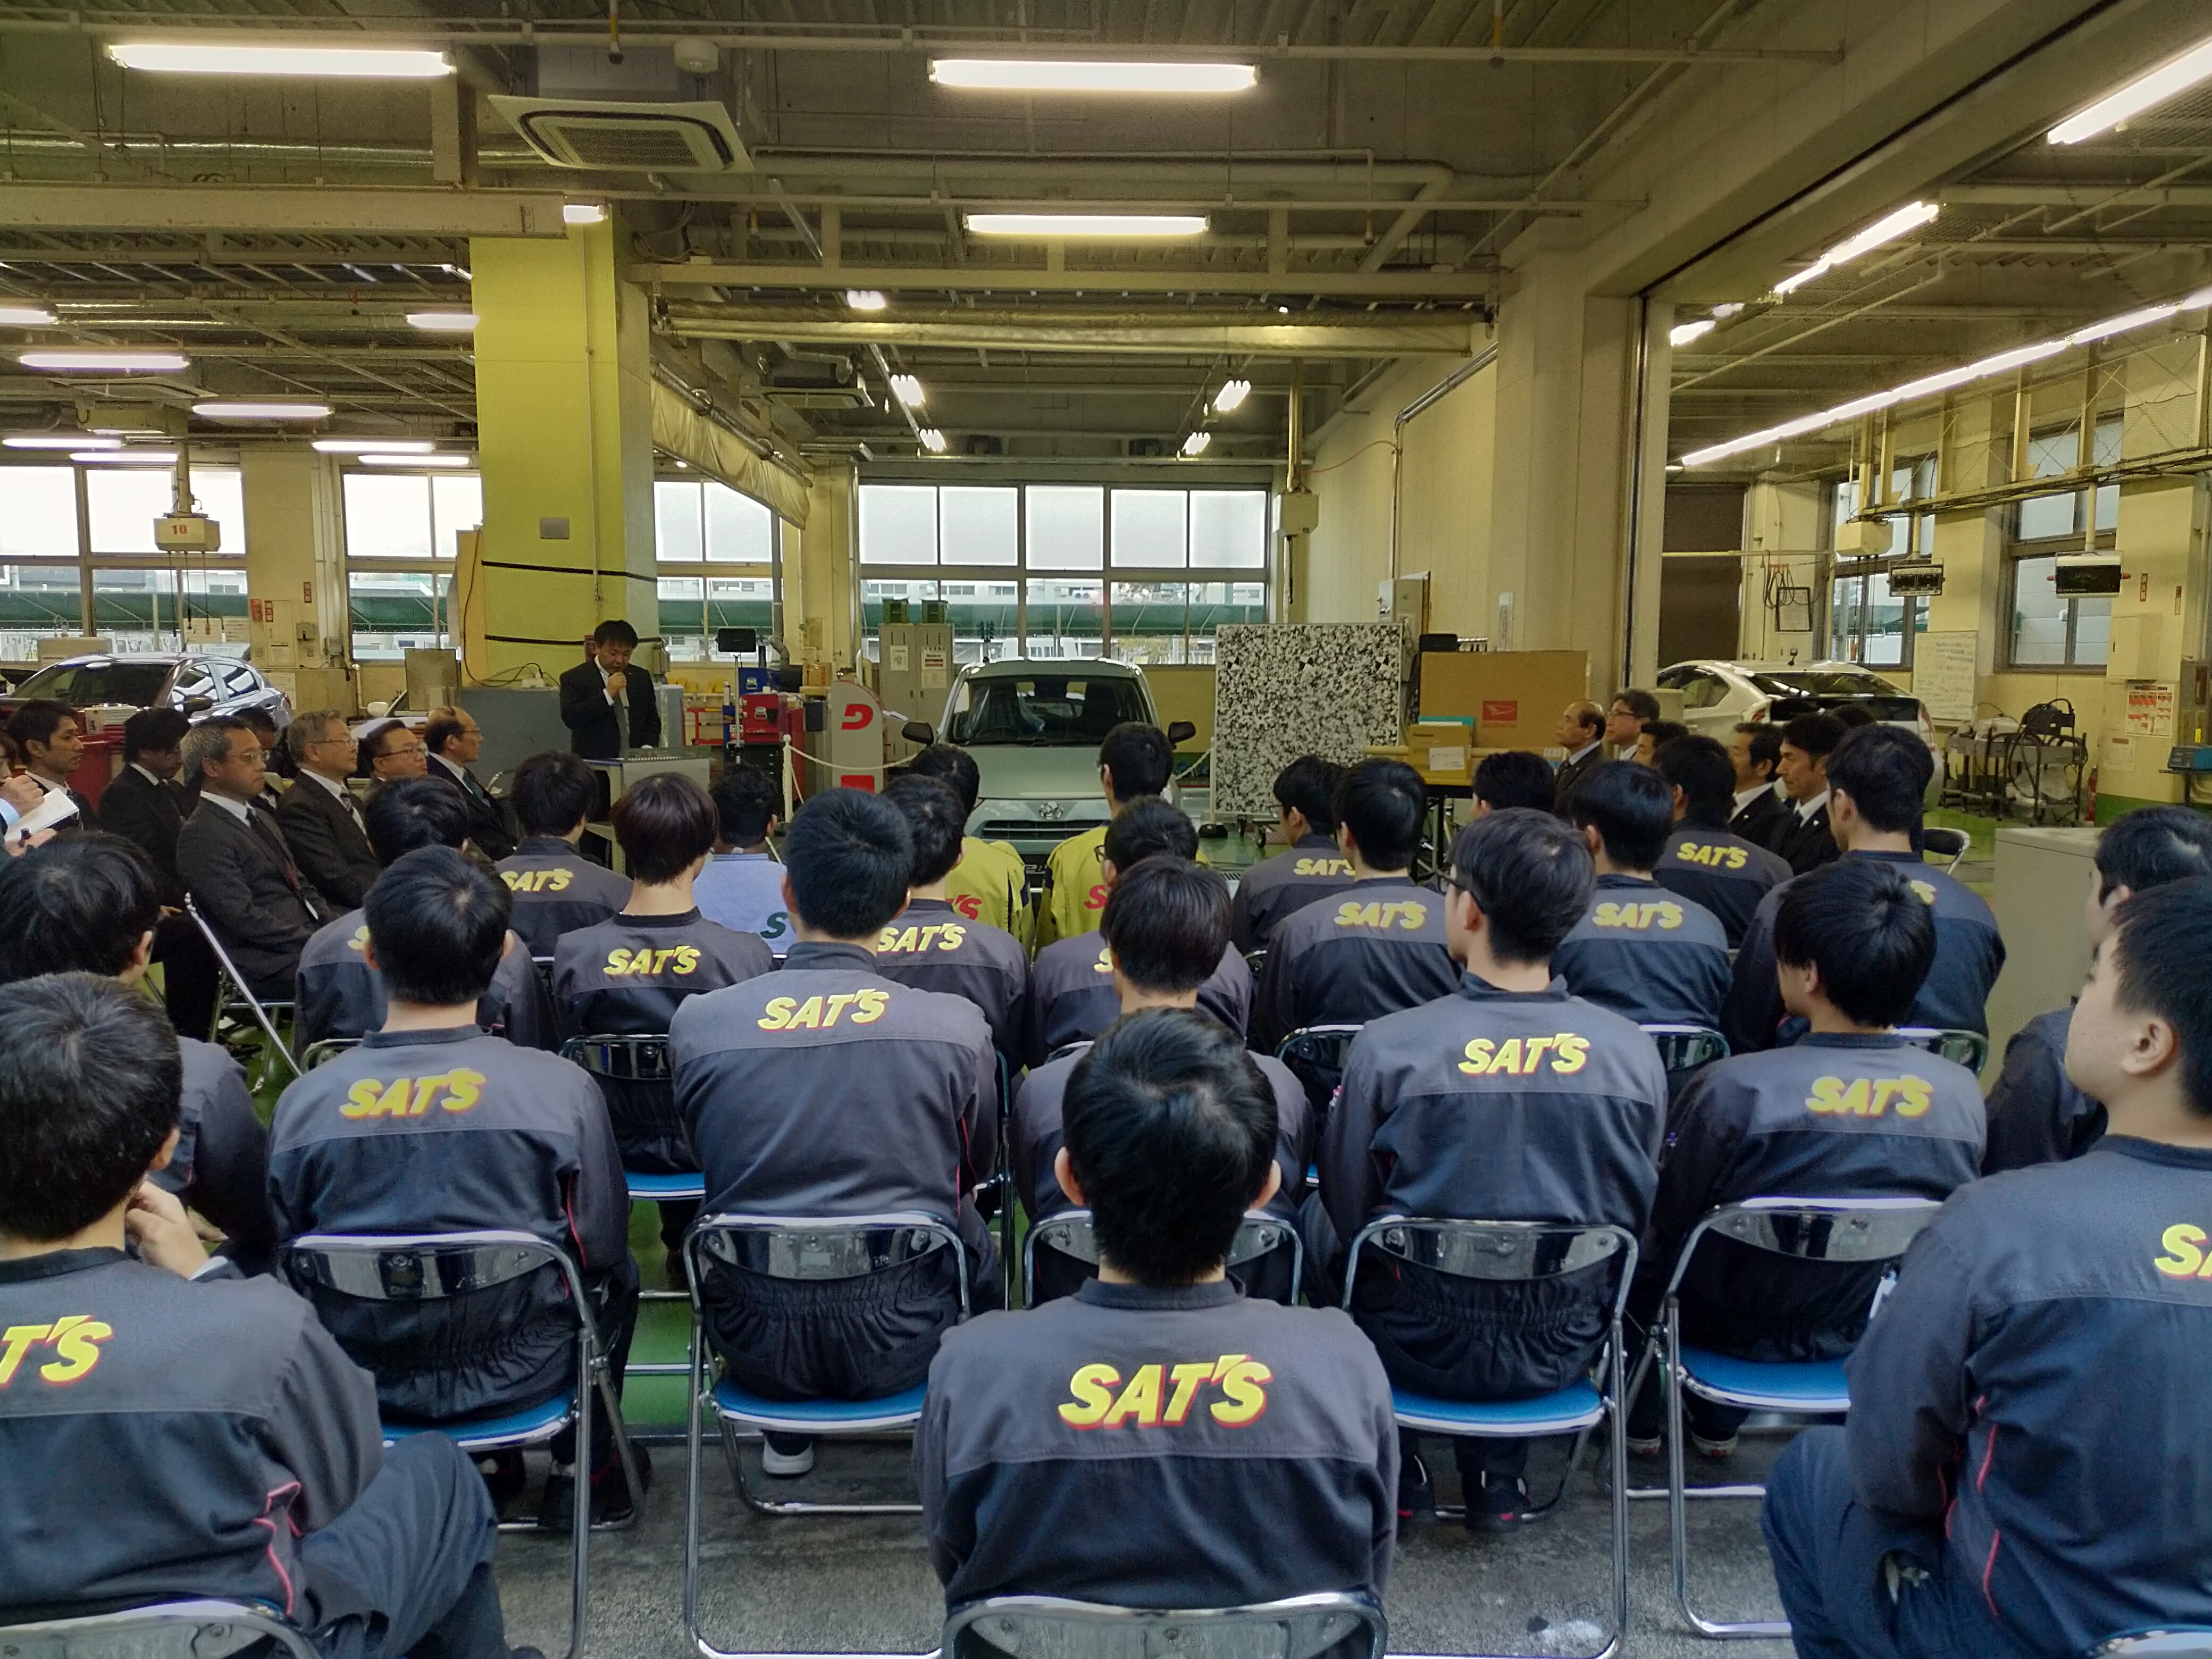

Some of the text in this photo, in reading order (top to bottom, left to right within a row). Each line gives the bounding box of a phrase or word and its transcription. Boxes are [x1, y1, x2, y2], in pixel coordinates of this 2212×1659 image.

[171, 524, 188, 535] 10
[1677, 842, 1749, 869] SAT'S
[1334, 901, 1427, 929] SAT'S
[1592, 901, 1683, 929] SAT'S
[878, 923, 967, 953] SAT'S
[603, 945, 701, 976] SAT'S
[757, 988, 890, 1033] SAT'S
[1457, 1033, 1591, 1076] SAT'S
[339, 1067, 487, 1119] SAT'S
[1805, 1074, 1934, 1118] SAT'S
[2154, 1224, 2212, 1280] S
[1057, 1354, 1275, 1430] SAT'S
